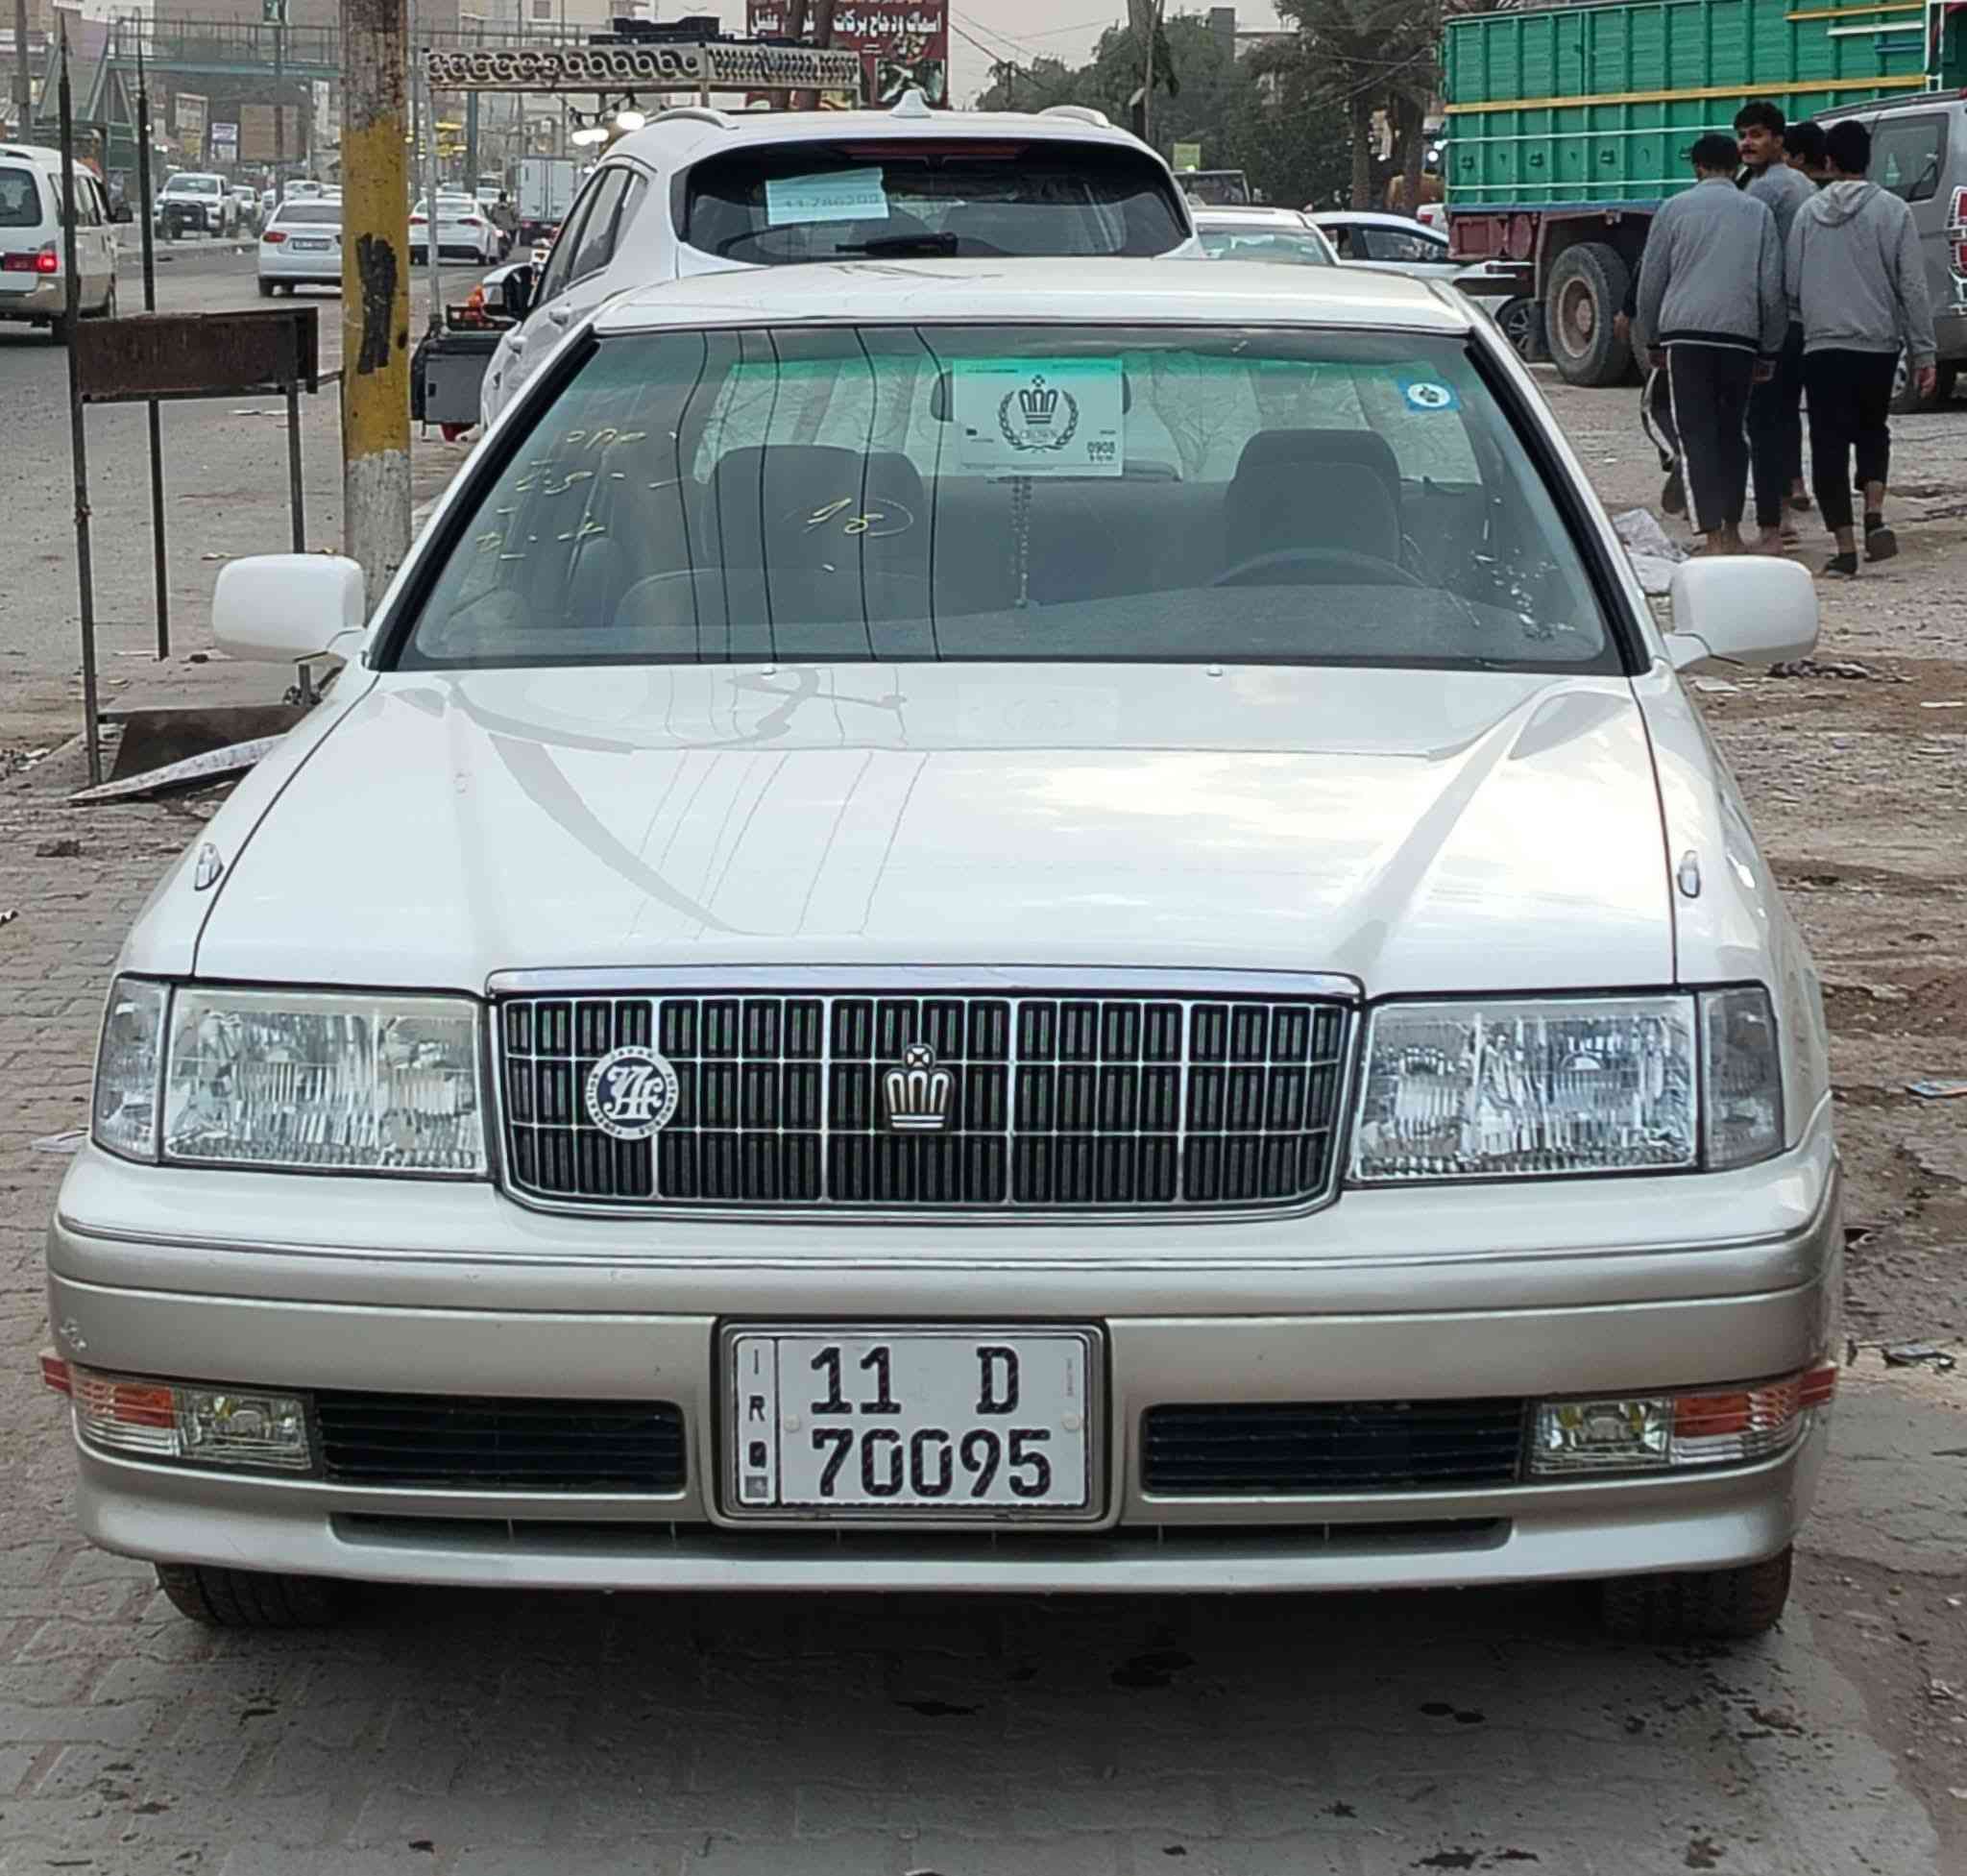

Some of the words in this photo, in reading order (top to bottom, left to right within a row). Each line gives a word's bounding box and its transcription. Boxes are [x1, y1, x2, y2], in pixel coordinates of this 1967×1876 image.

[811, 1346, 902, 1415] 11
[976, 1346, 1019, 1415] D
[812, 1428, 1051, 1498] 70095
